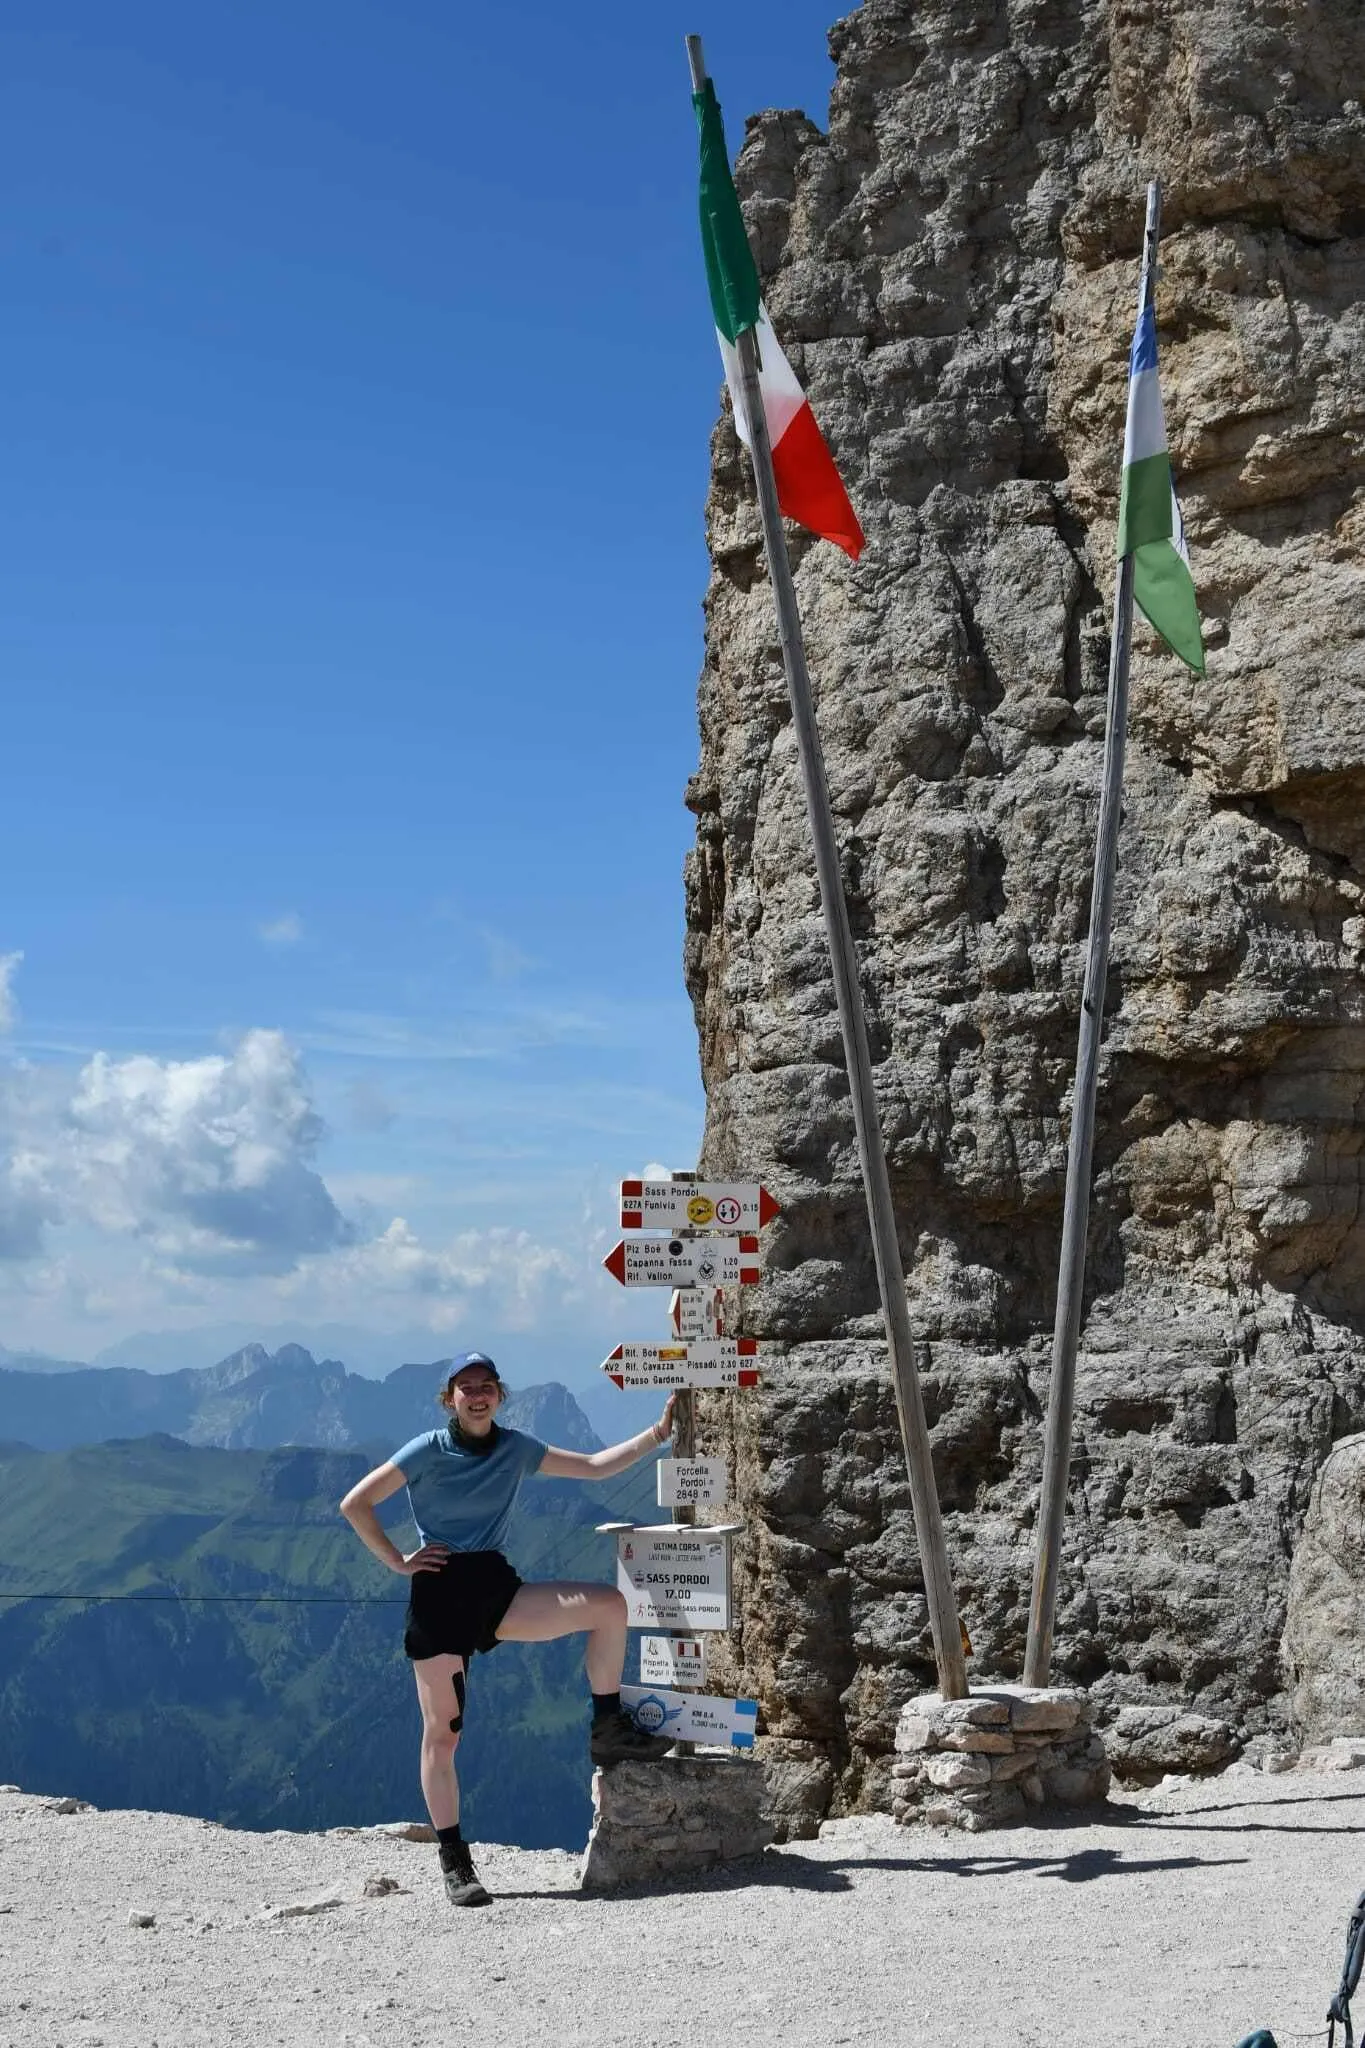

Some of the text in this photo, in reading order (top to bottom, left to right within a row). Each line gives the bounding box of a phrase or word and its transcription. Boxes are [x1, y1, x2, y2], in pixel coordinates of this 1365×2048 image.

[644, 1187, 699, 1197] Sass Pordoi
[644, 1202, 676, 1210] Funivia
[742, 1204, 758, 1212] 0.15
[626, 1245, 640, 1253] Piz
[627, 1258, 665, 1268] Capanna
[724, 1258, 738, 1266] 1.20
[627, 1272, 642, 1281] Rif.
[647, 1272, 673, 1280] Vallon
[625, 1349, 639, 1358] Rif.
[625, 1363, 639, 1371] Rif.
[643, 1362, 675, 1370] Cavazza
[740, 1359, 753, 1368] 627
[625, 1376, 649, 1385] Passo
[653, 1376, 684, 1384] Gardena
[676, 1466, 709, 1476] Forcella
[680, 1478, 706, 1487] Pordoi
[676, 1490, 698, 1499] 2848
[646, 1573, 710, 1585] SASS PORDOI
[665, 1589, 691, 1599] 17.00
